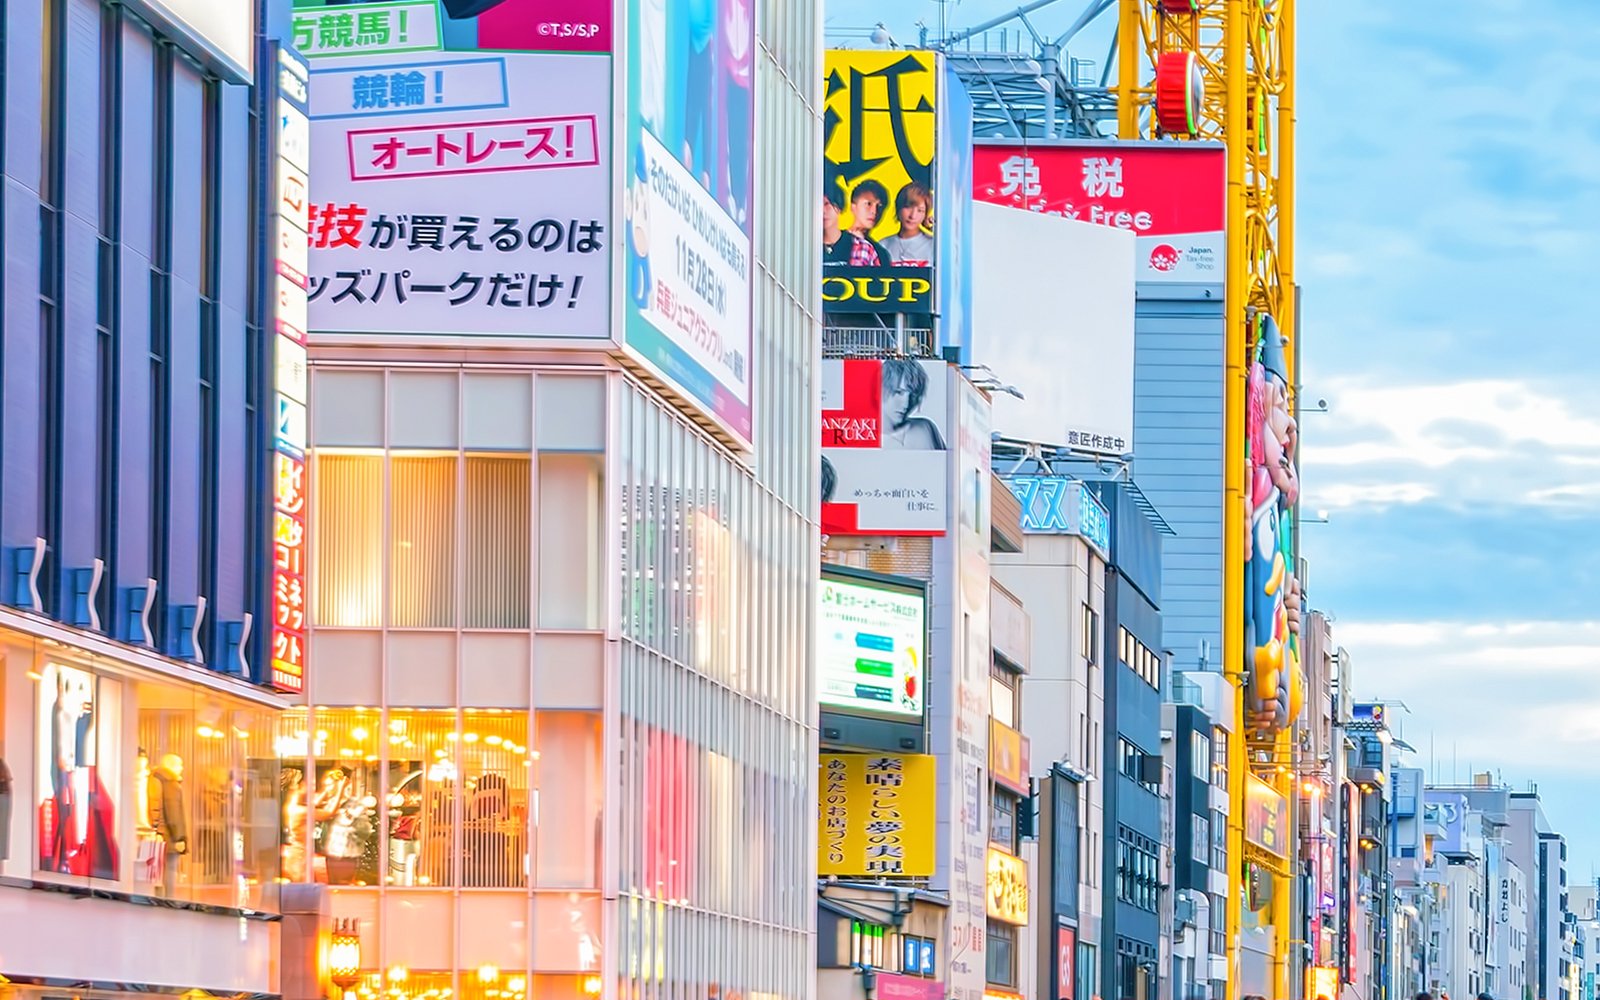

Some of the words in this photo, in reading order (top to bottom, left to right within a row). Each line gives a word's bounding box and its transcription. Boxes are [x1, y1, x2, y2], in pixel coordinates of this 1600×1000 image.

[352, 71, 444, 109] 競輪!
[371, 125, 575, 170] オートレース!
[1000, 156, 1124, 198] 免税
[1068, 429, 1127, 451] 意匠作成中
[826, 758, 848, 865] あなたのお店づくり
